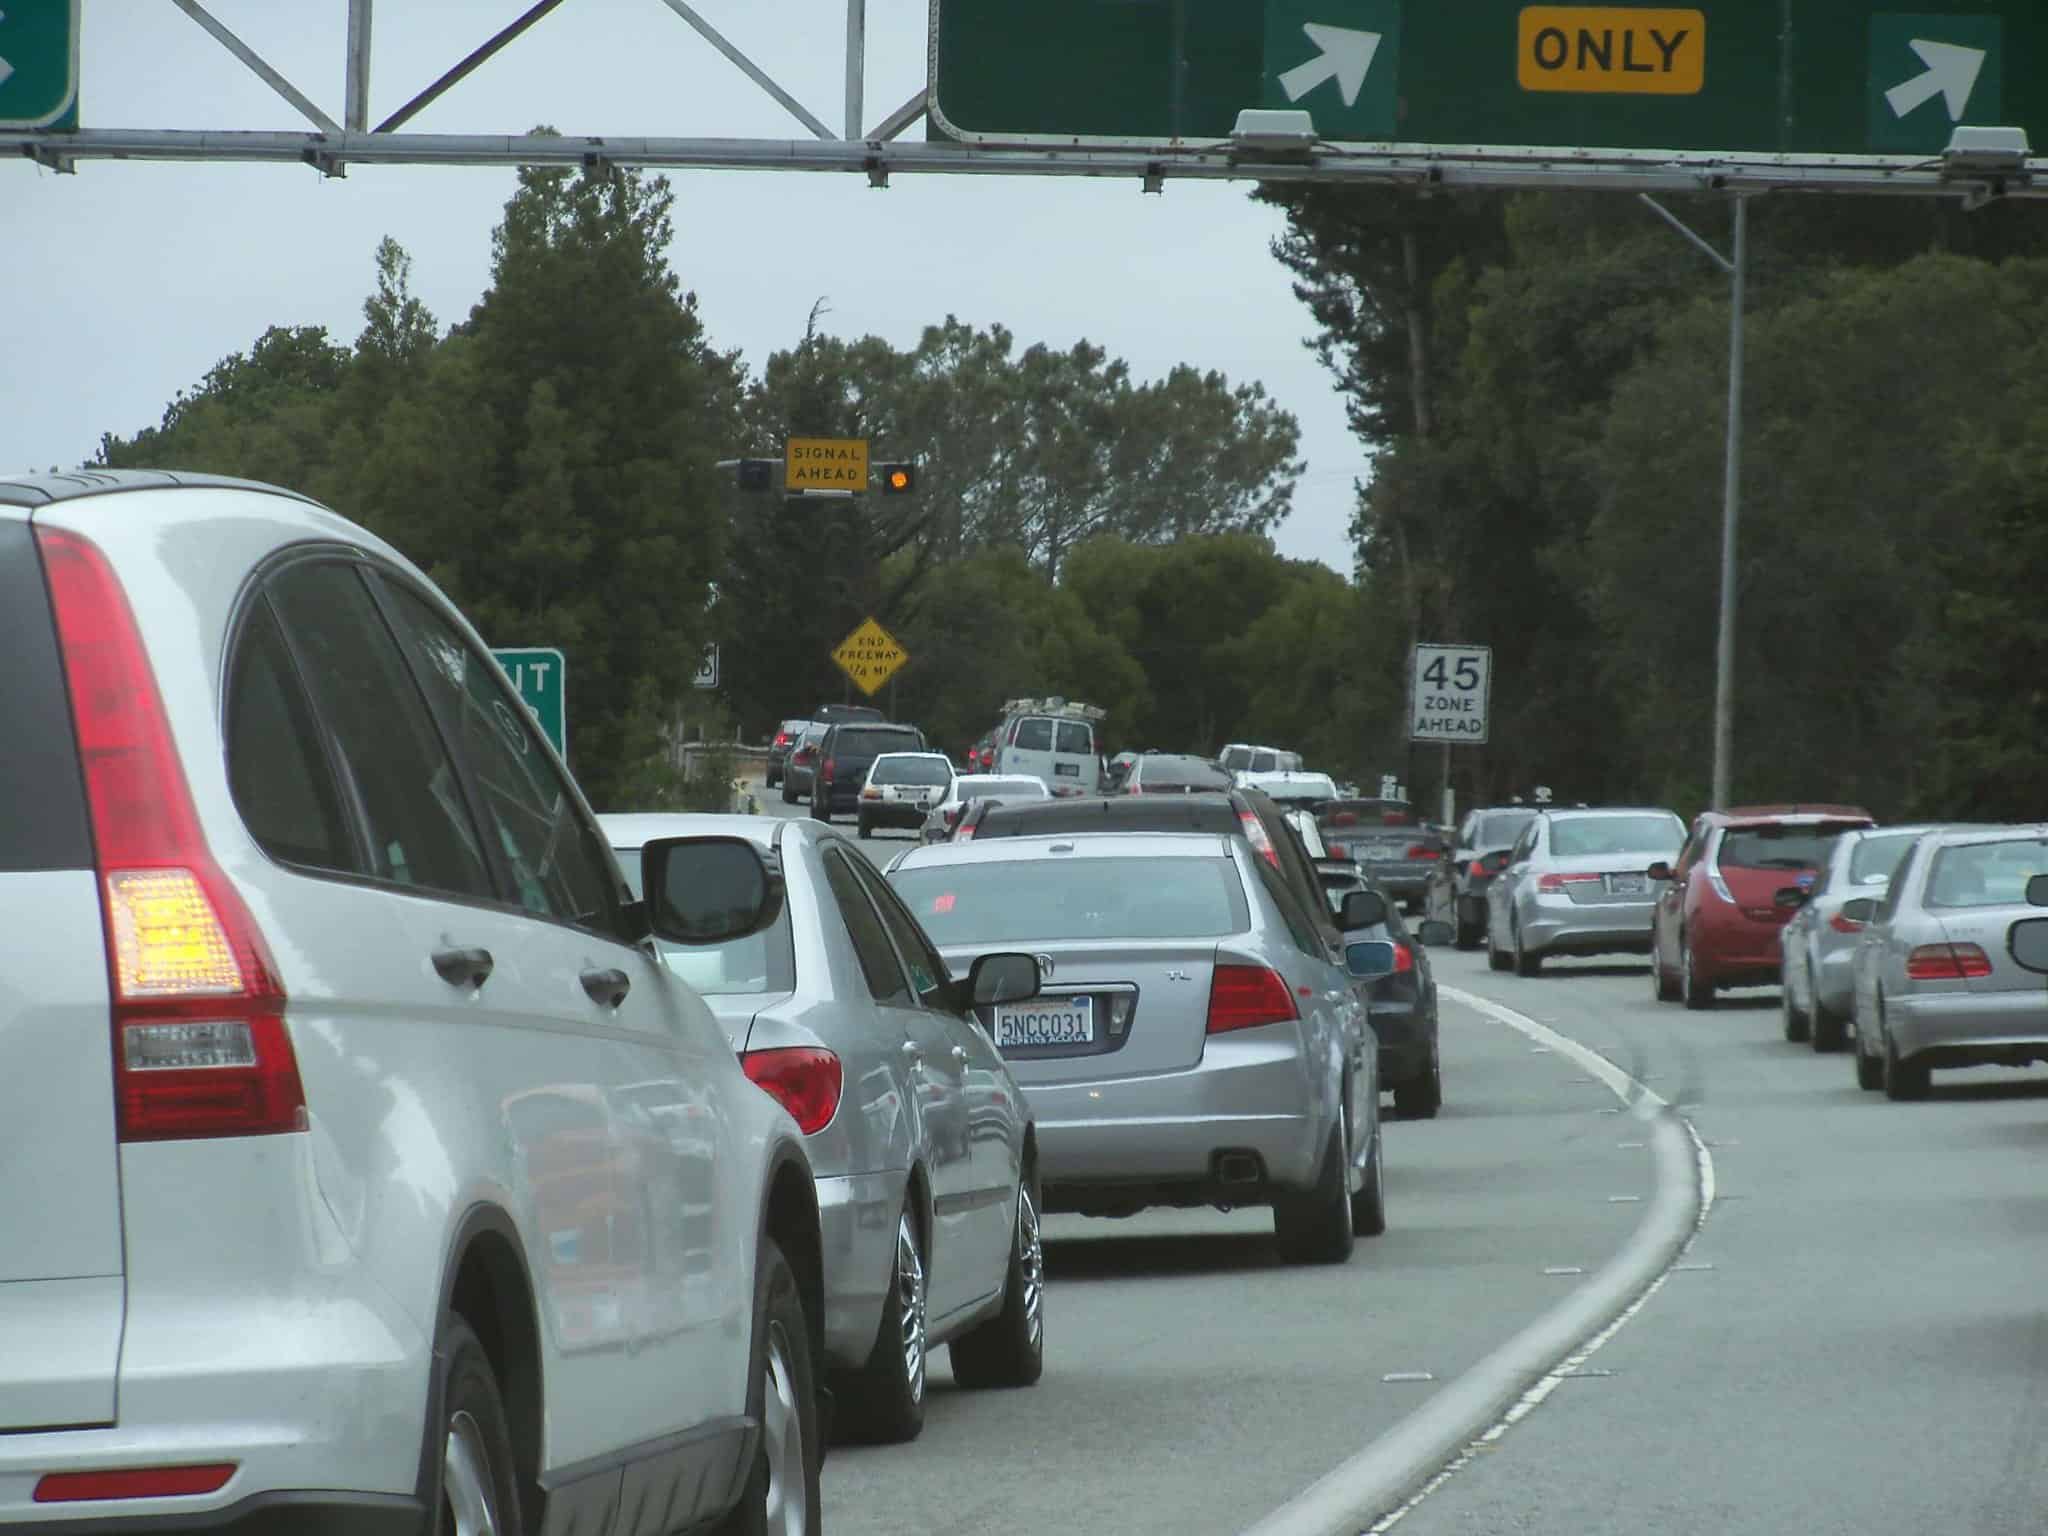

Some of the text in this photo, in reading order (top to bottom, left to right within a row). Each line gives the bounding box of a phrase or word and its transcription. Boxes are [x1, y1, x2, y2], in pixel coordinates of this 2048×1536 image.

[1533, 27, 1689, 72] ONLY
[794, 447, 860, 460] SIGNAL
[796, 467, 857, 480] AHEAD
[858, 637, 884, 646] END
[840, 650, 898, 660] FREEWAY
[1423, 655, 1480, 690] 45
[1424, 696, 1475, 712] ZONE
[1416, 718, 1482, 733] AHEAD
[1001, 1013, 1085, 1038] 5NCC031
